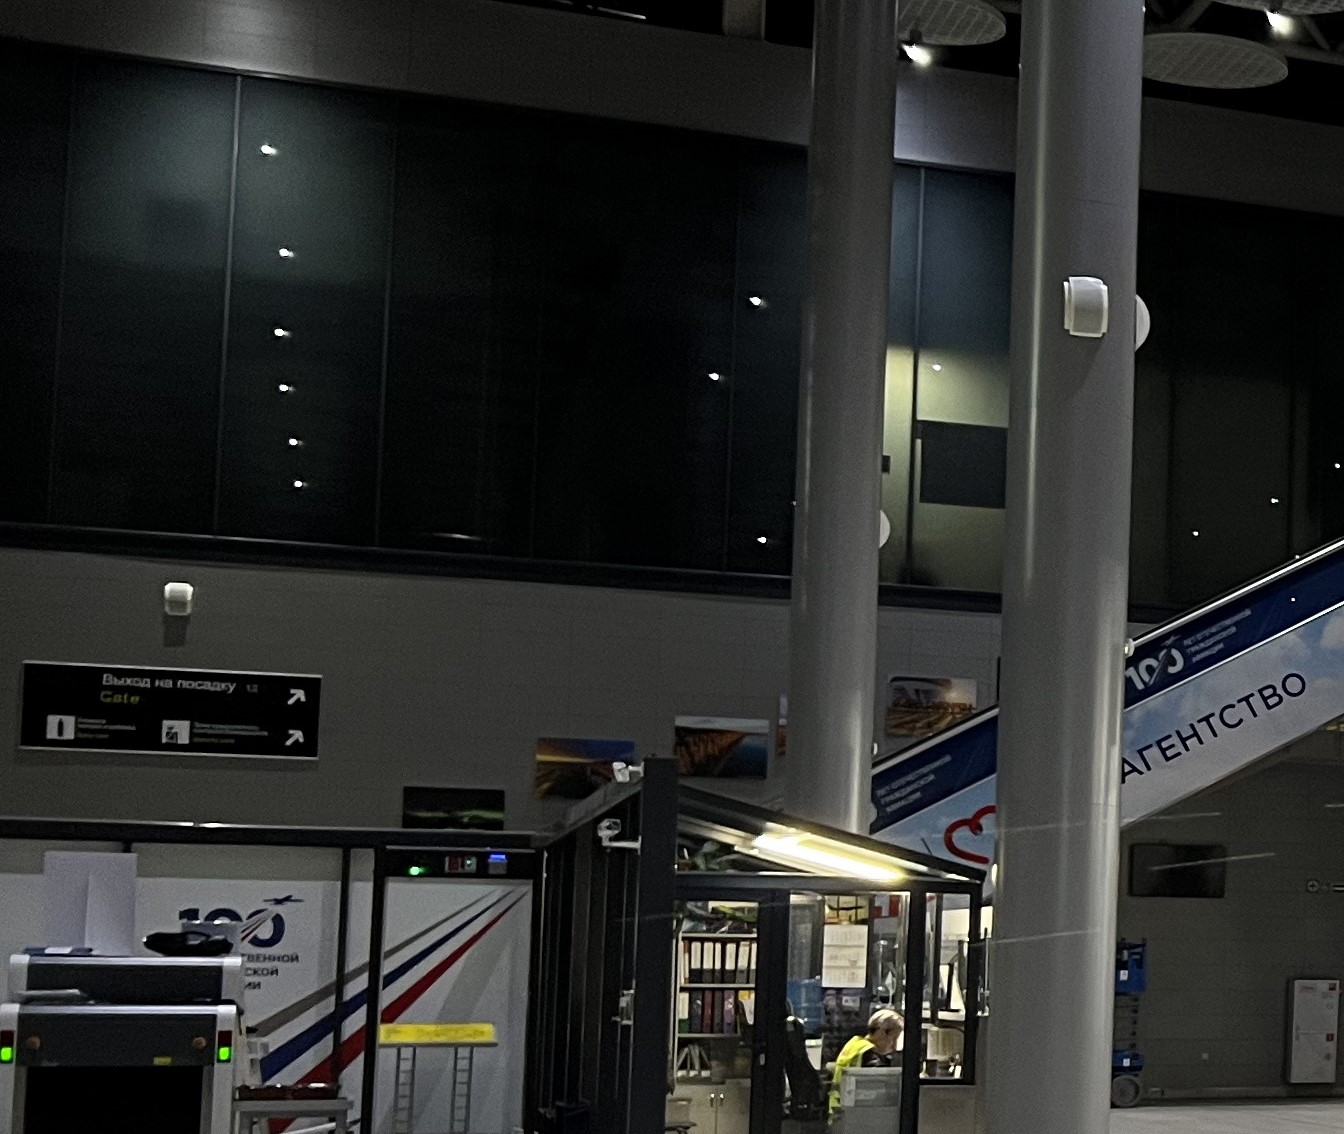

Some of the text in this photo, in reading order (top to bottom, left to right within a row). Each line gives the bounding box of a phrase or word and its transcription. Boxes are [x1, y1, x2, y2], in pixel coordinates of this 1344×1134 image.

[102, 673, 151, 689] Выход
[155, 678, 173, 689] на
[177, 679, 237, 694] посадку
[100, 690, 140, 705] Gate
[1121, 673, 1306, 784] АГЕНТСТВО
[241, 953, 300, 963] ТВЕННОЙ
[245, 966, 279, 977] СКОЙ
